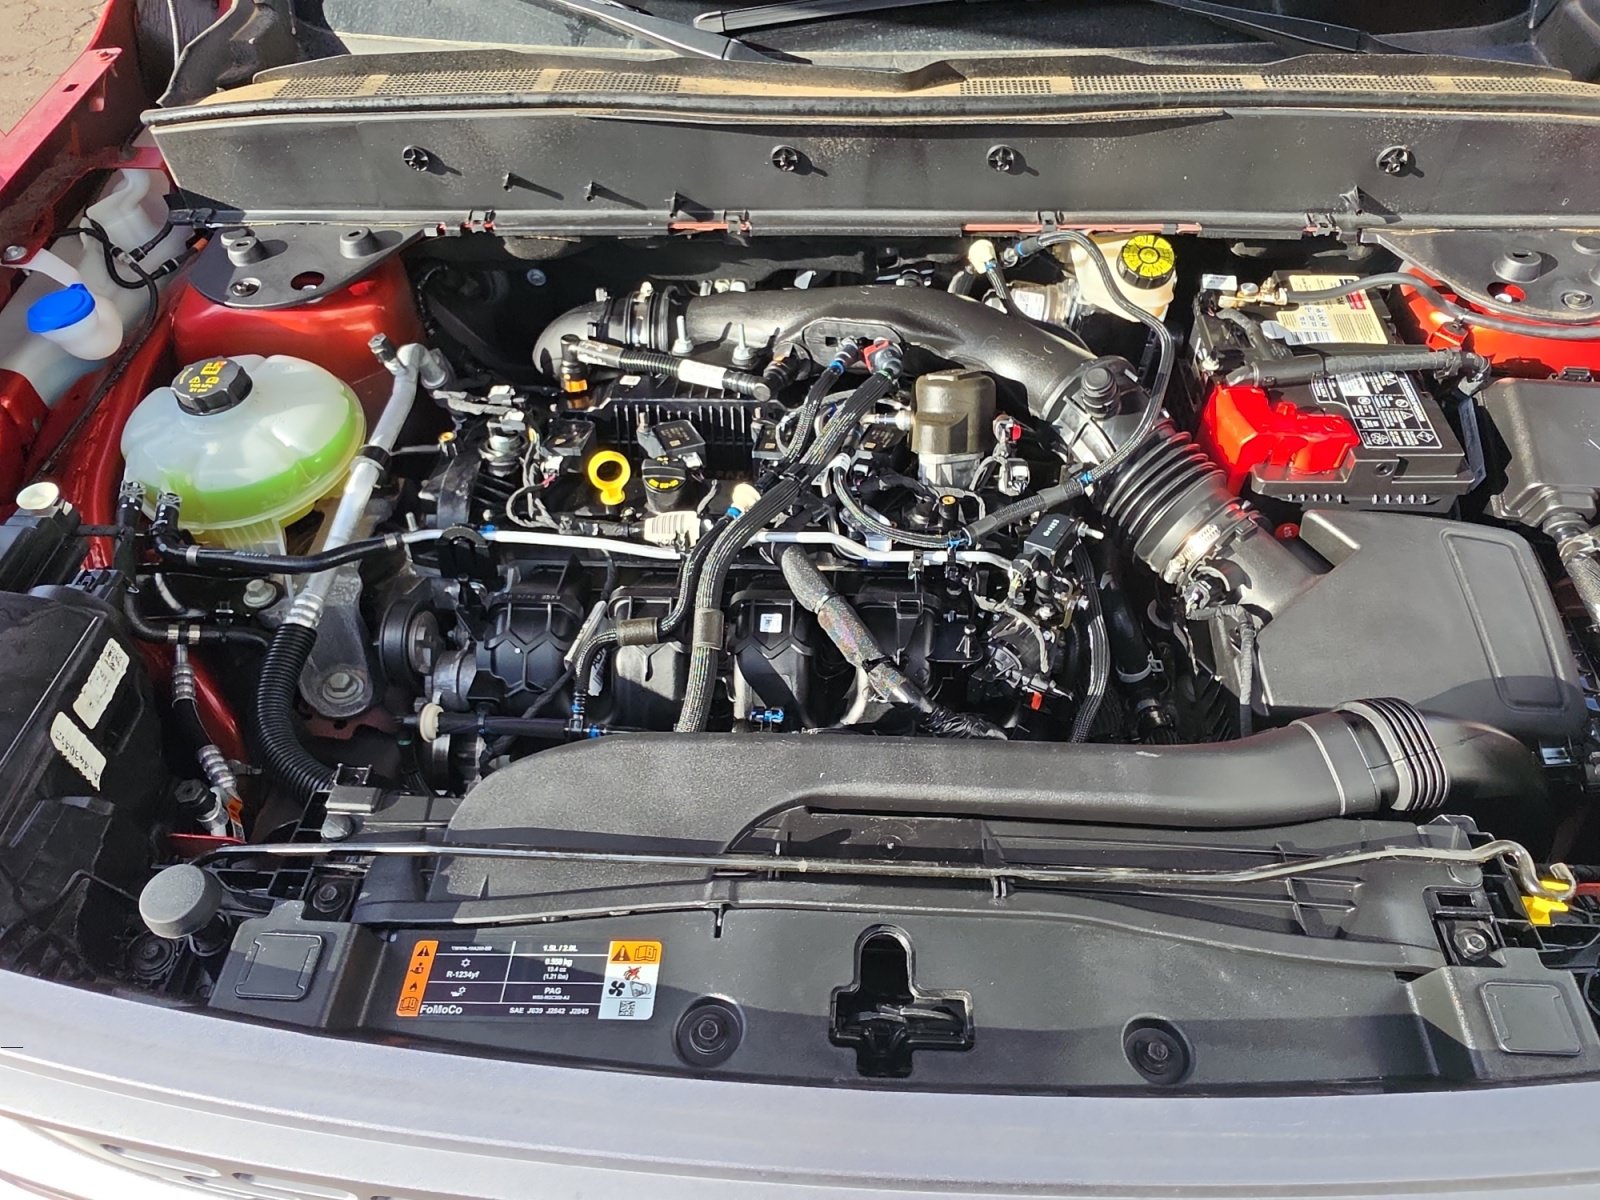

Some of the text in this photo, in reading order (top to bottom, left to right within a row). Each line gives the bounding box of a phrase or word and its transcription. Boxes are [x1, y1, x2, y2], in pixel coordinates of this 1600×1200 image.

[446, 971, 480, 980] R-1234yf
[543, 987, 562, 995] PAG
[419, 1004, 463, 1014] FoMoCo
